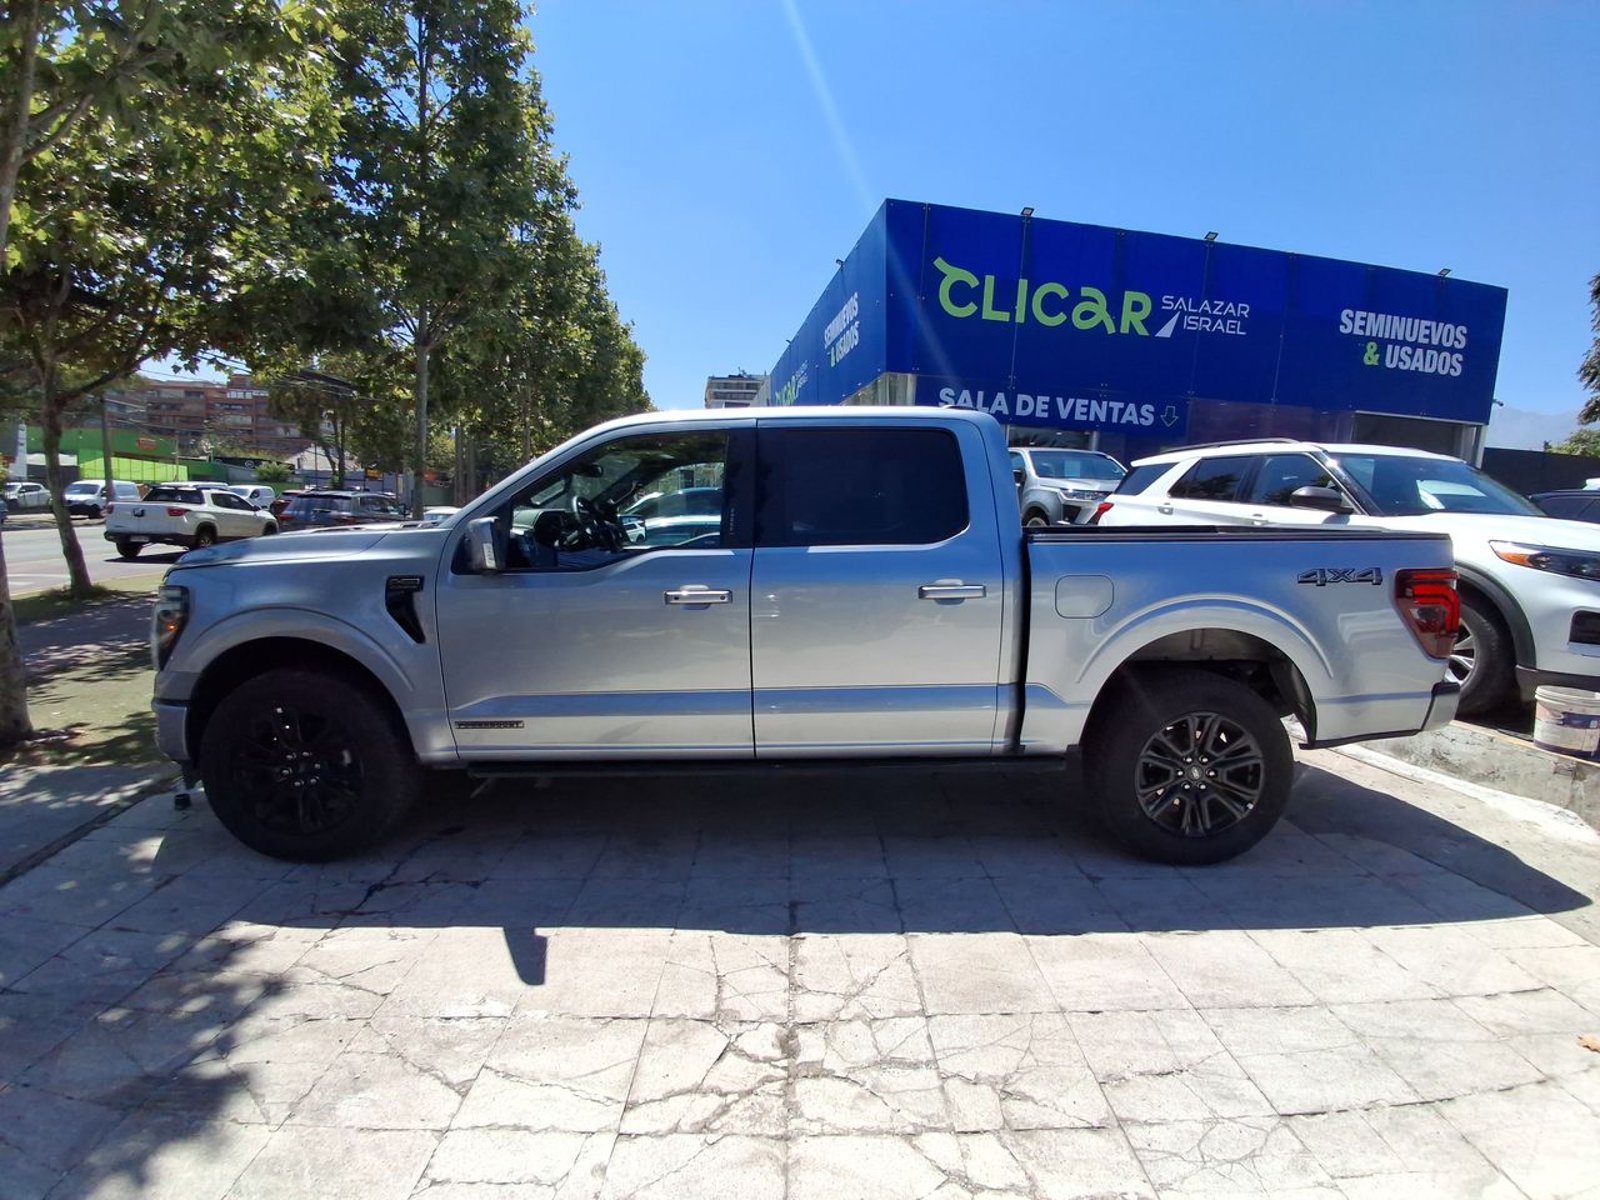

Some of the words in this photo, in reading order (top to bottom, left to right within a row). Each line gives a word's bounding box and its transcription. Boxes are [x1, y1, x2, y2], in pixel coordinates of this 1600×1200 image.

[1161, 295, 1250, 318] SALAZAR
[1183, 315, 1247, 335] ISRAEL
[1339, 308, 1468, 349] SEMINUEVOS
[1363, 341, 1380, 366] &
[1385, 344, 1464, 377] USADOS
[938, 388, 1009, 416] SALA
[1015, 394, 1050, 418] DE
[1056, 397, 1155, 427] VENTAS
